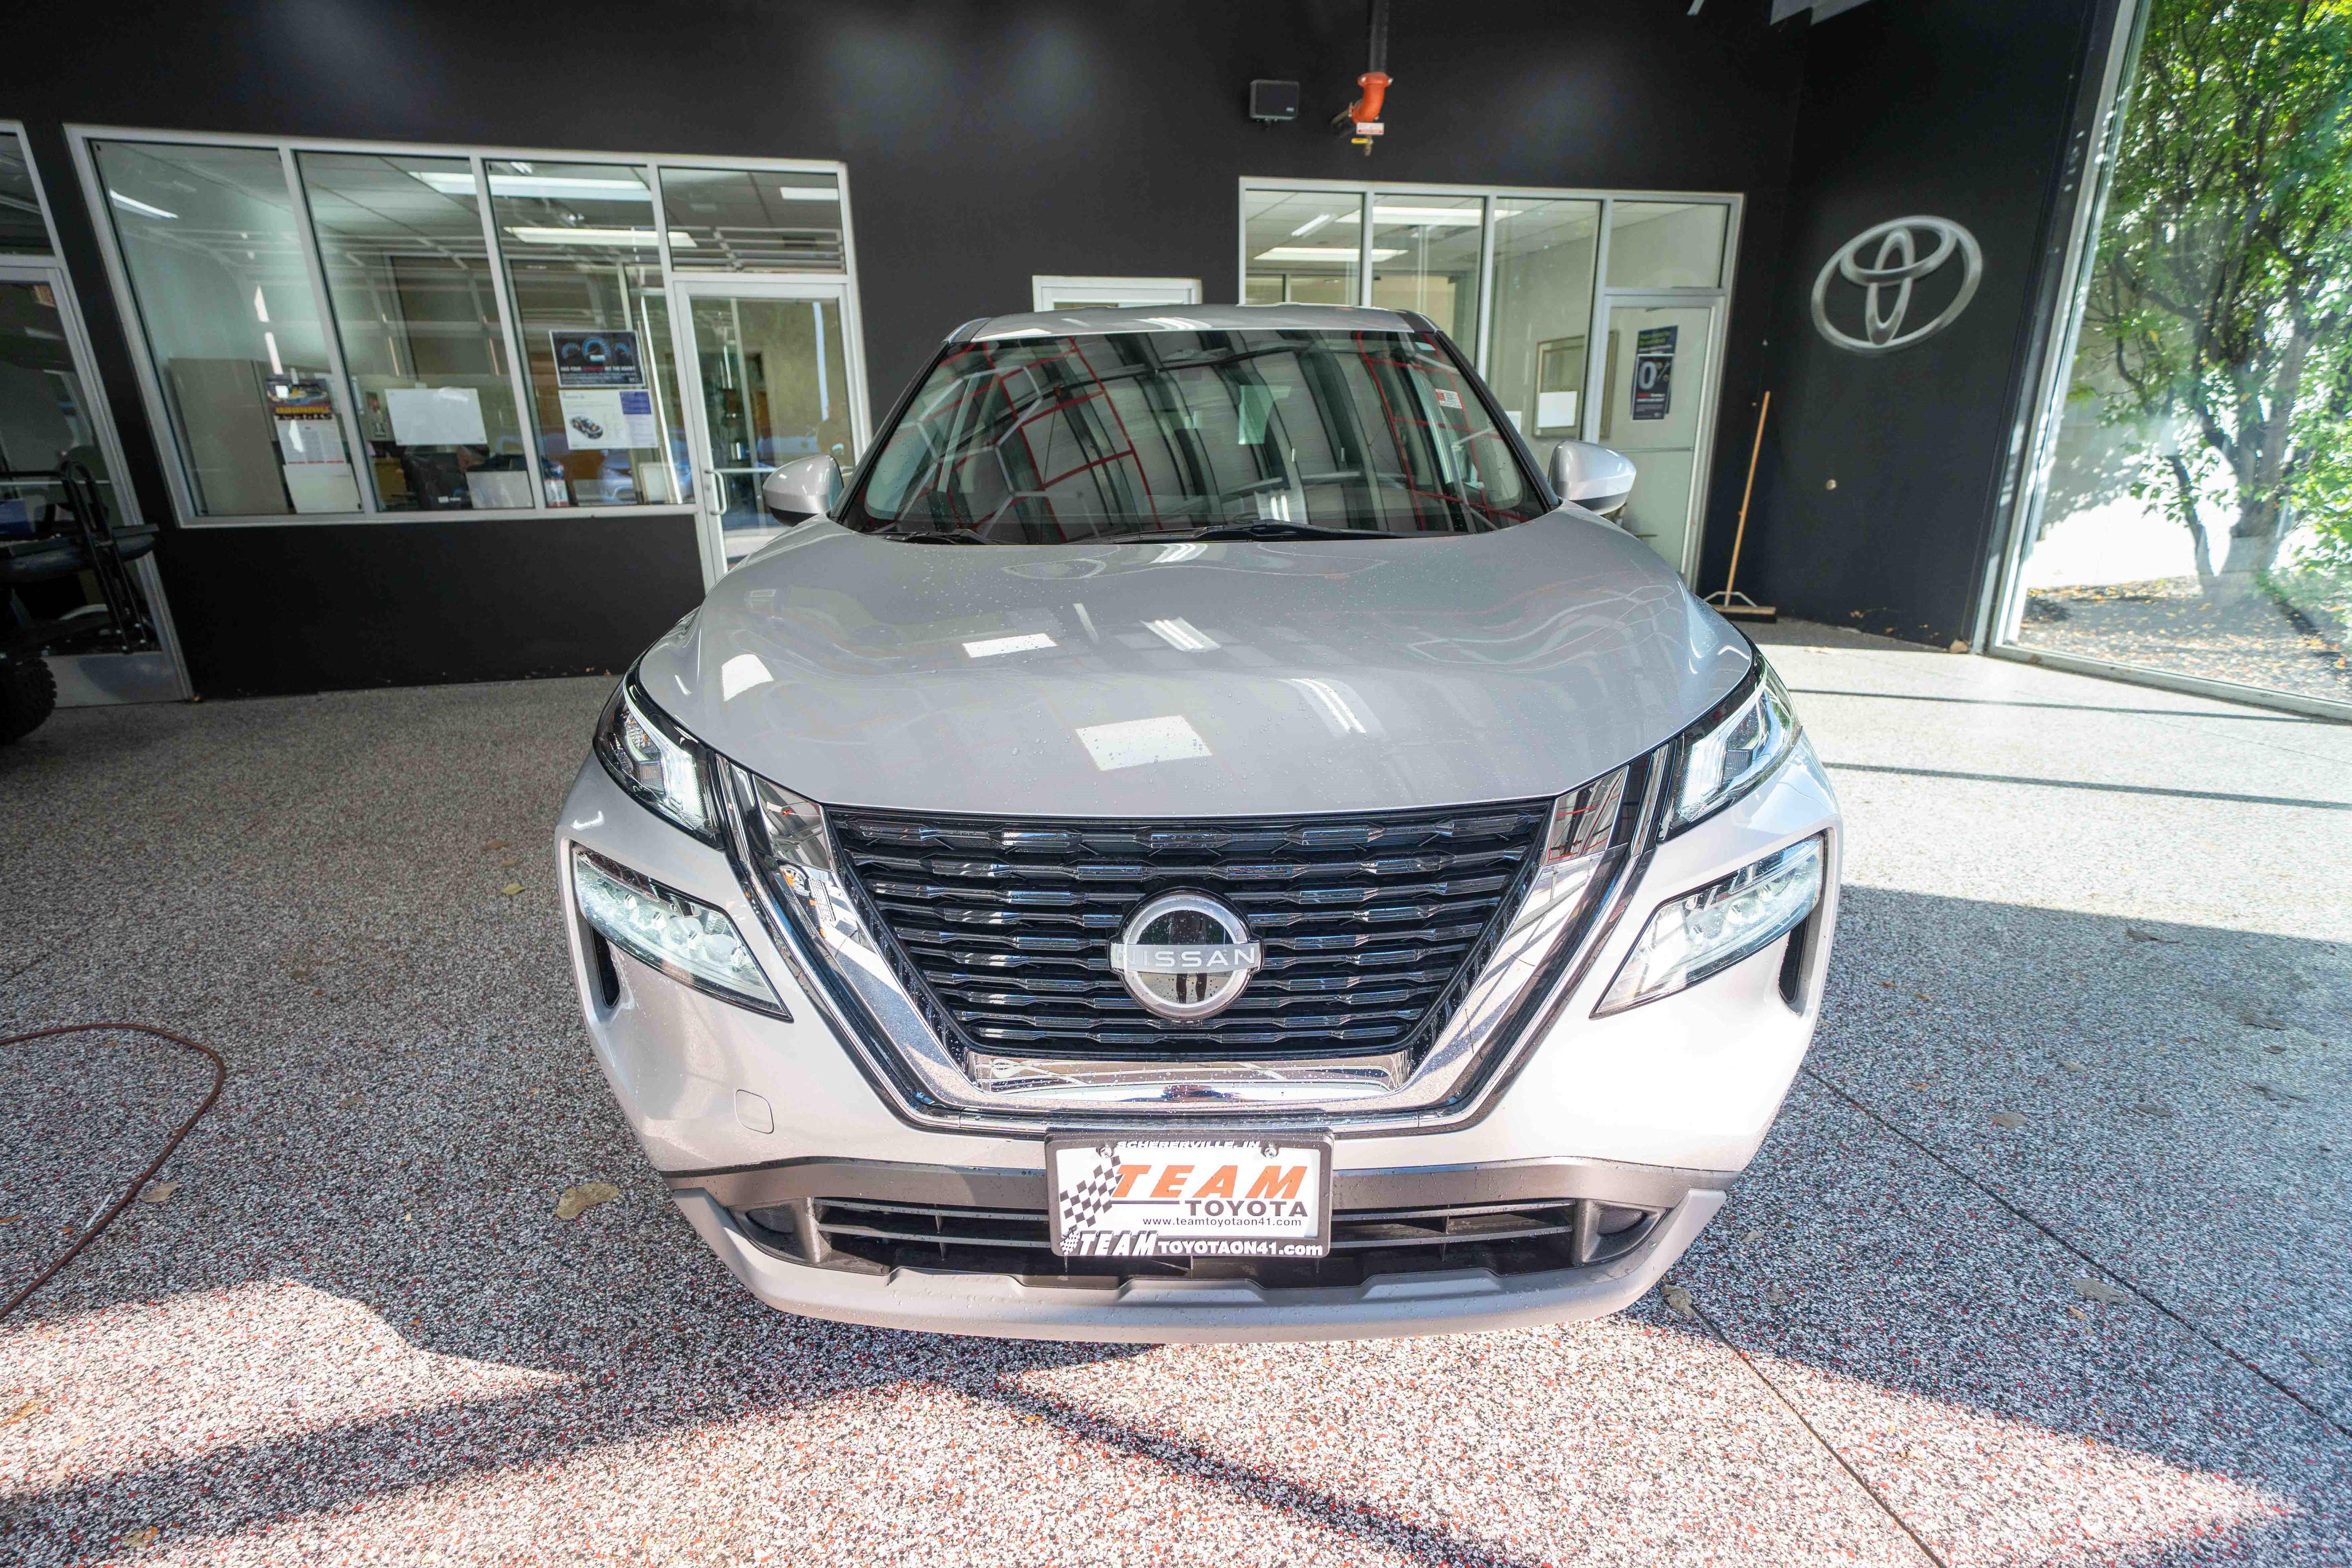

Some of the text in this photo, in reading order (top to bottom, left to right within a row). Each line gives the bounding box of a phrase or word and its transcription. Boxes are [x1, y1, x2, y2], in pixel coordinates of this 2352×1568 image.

[1116, 947, 1255, 967] NISSAN
[1112, 1165, 1307, 1199] TEAM
[1185, 1200, 1308, 1216] TOYOTA
[1143, 1216, 1301, 1227] www.teamtoyotaon41.com
[1080, 1230, 1323, 1256] TEAM TOYOTAON41.com
